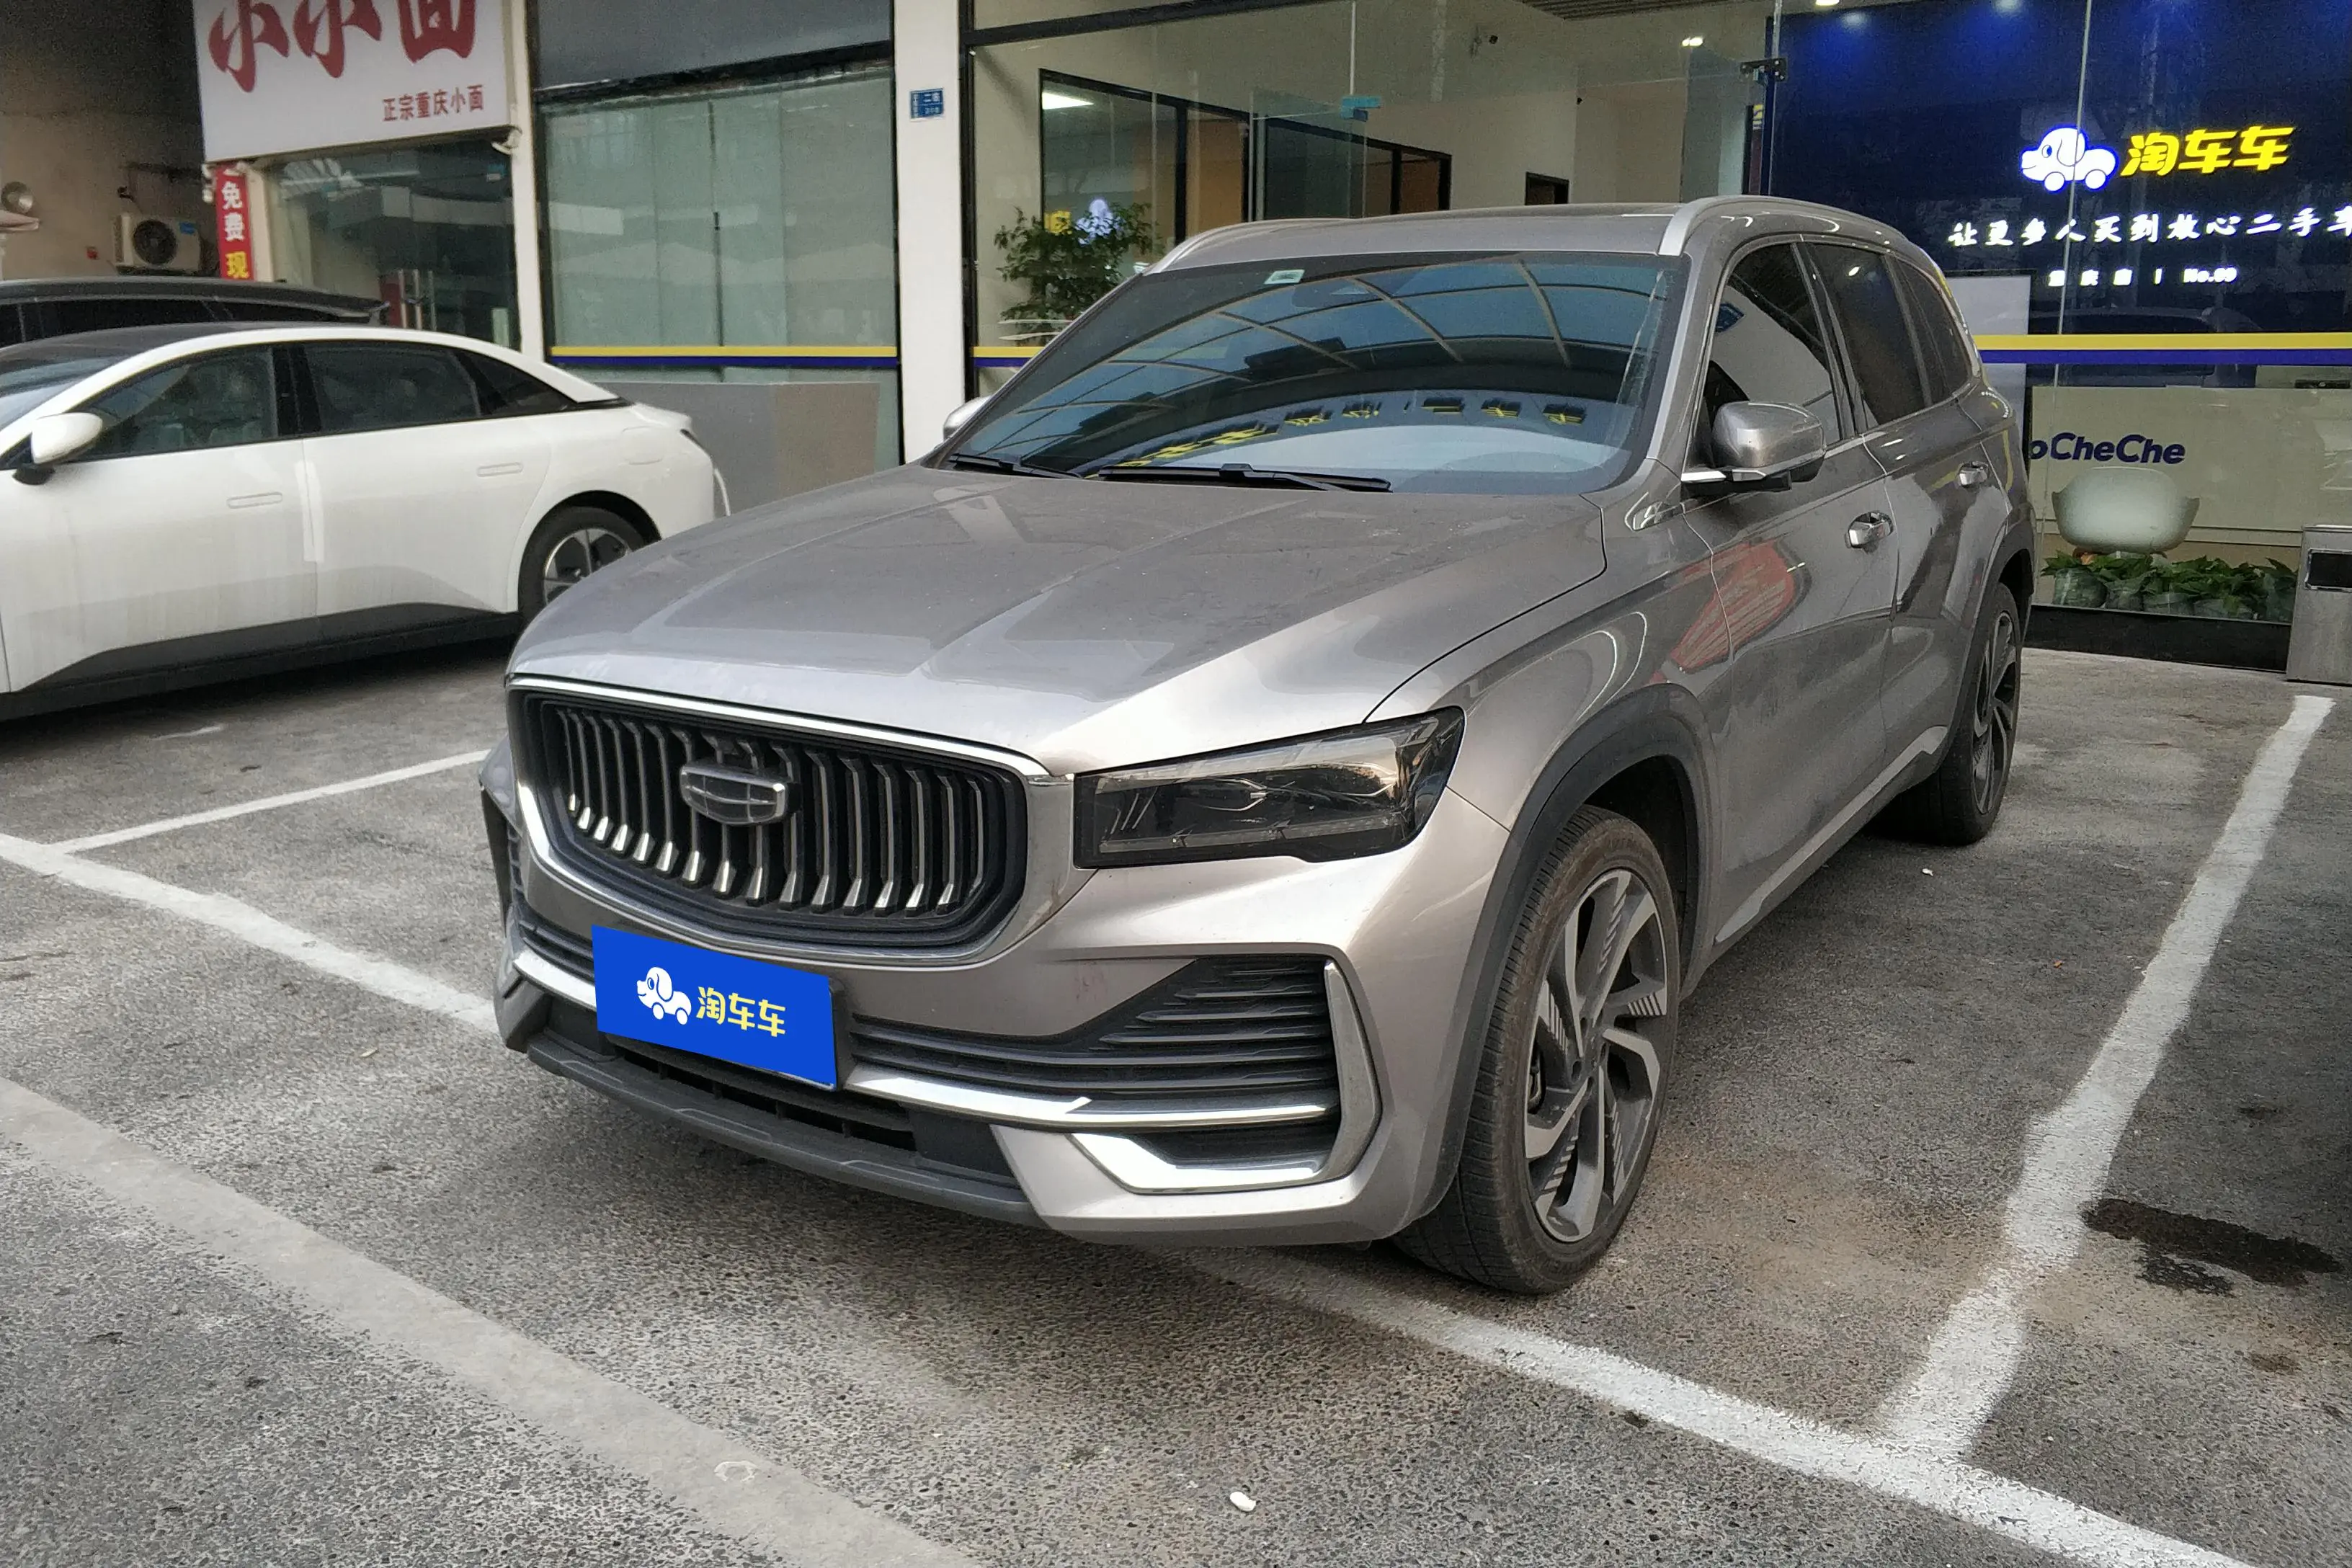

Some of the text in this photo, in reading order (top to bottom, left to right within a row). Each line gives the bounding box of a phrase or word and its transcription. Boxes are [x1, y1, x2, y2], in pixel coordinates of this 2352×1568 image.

[383, 84, 484, 121] 正宗重庆小面
[2120, 125, 2294, 176] 淘车车
[221, 168, 250, 279] 免费现
